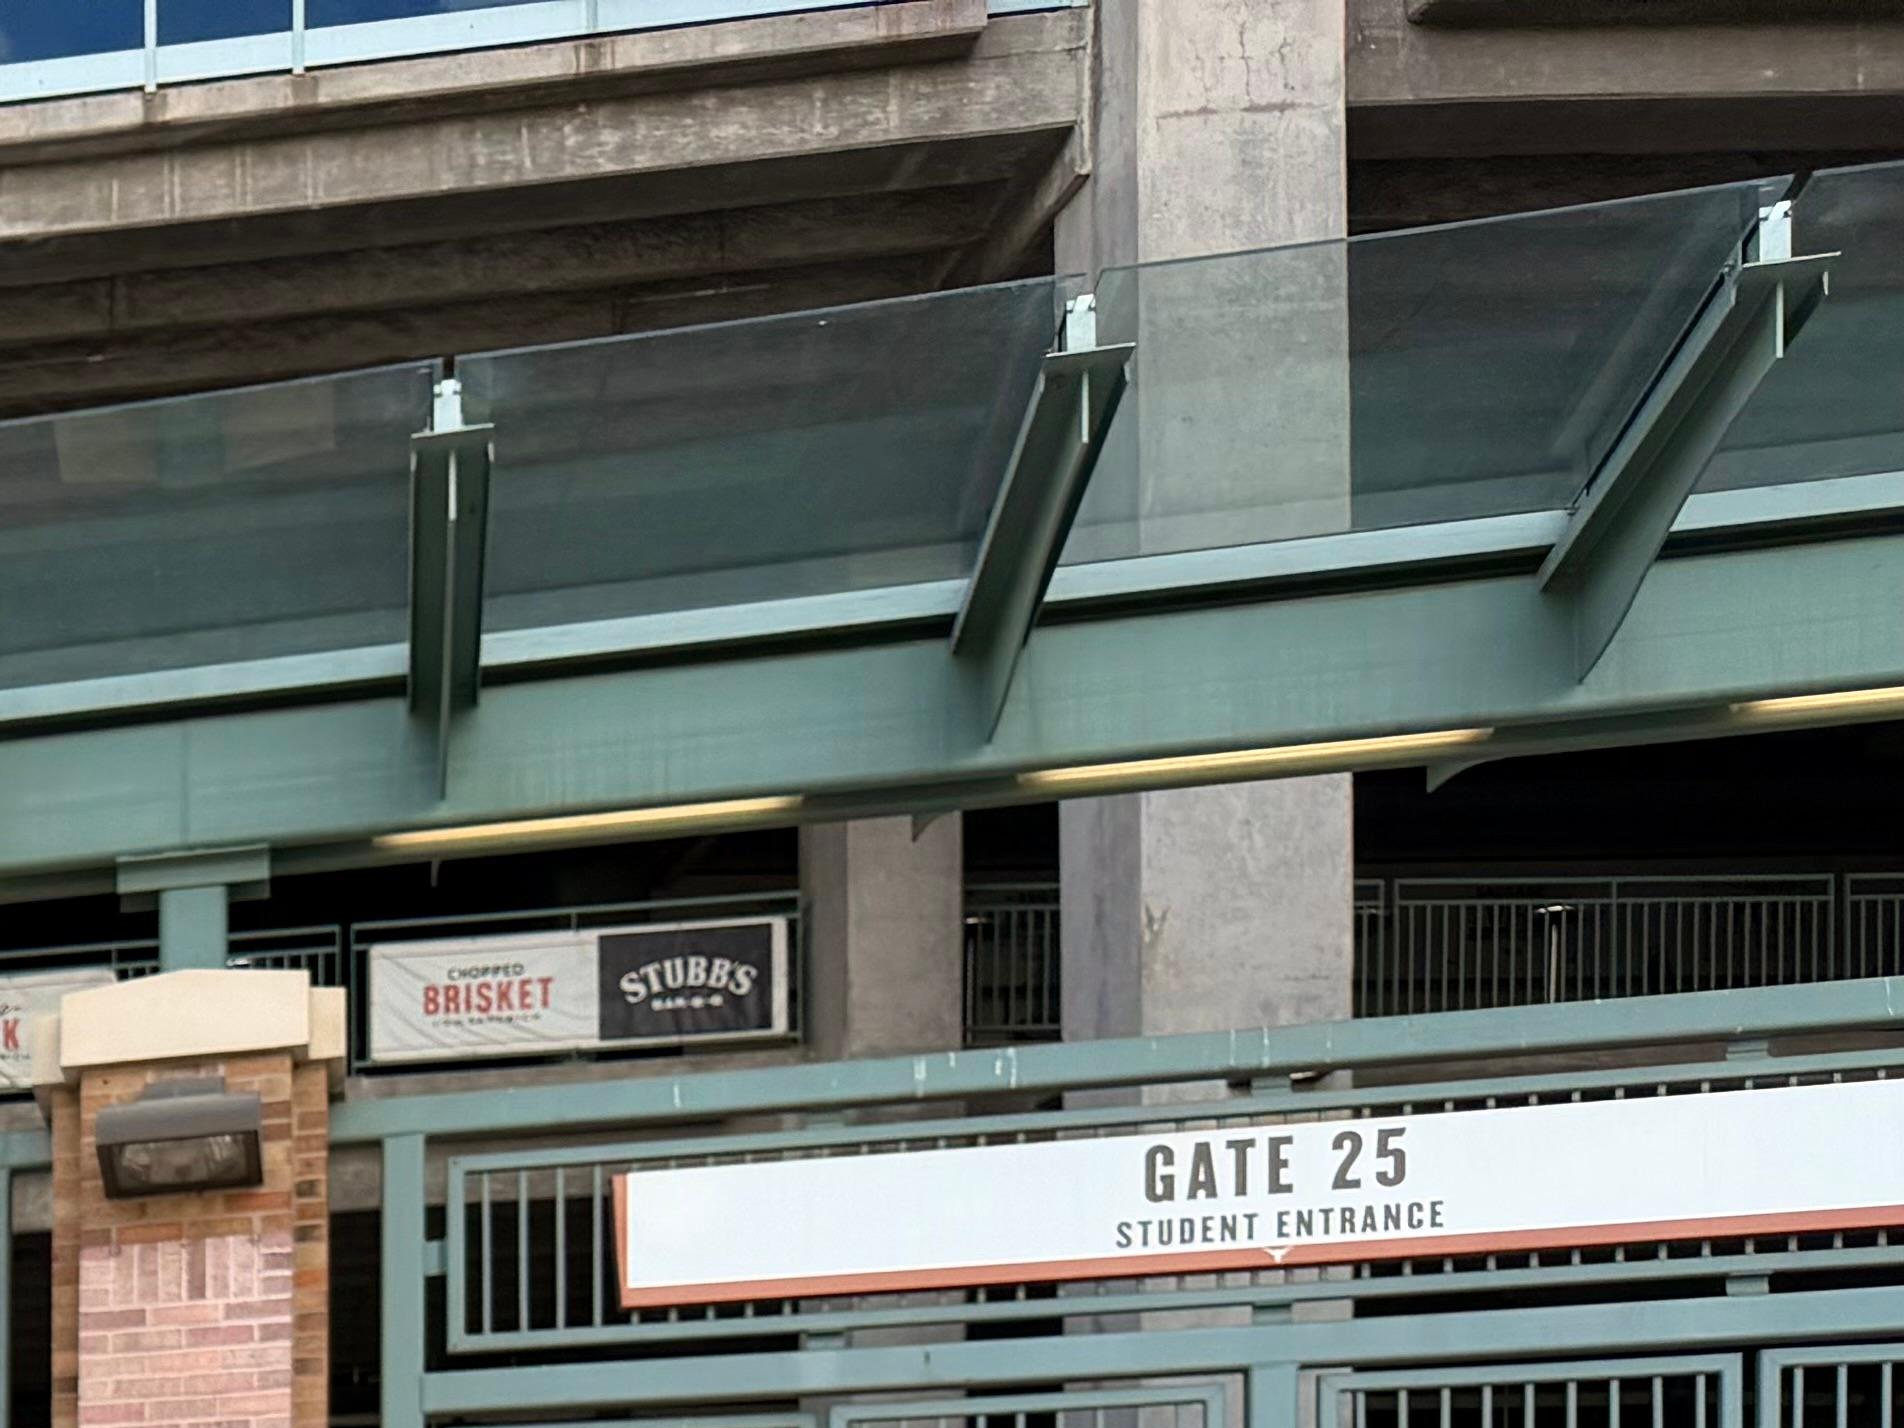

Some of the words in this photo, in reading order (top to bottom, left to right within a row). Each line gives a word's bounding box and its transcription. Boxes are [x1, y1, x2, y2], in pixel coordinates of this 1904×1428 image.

[423, 977, 554, 1016] BRISKET
[619, 955, 758, 1004] STUBB'S
[1145, 1134, 1294, 1203] GATE
[1331, 1126, 1407, 1191] 25
[1115, 1212, 1259, 1248] STUDENT
[1276, 1200, 1445, 1239] ENTRANCE
